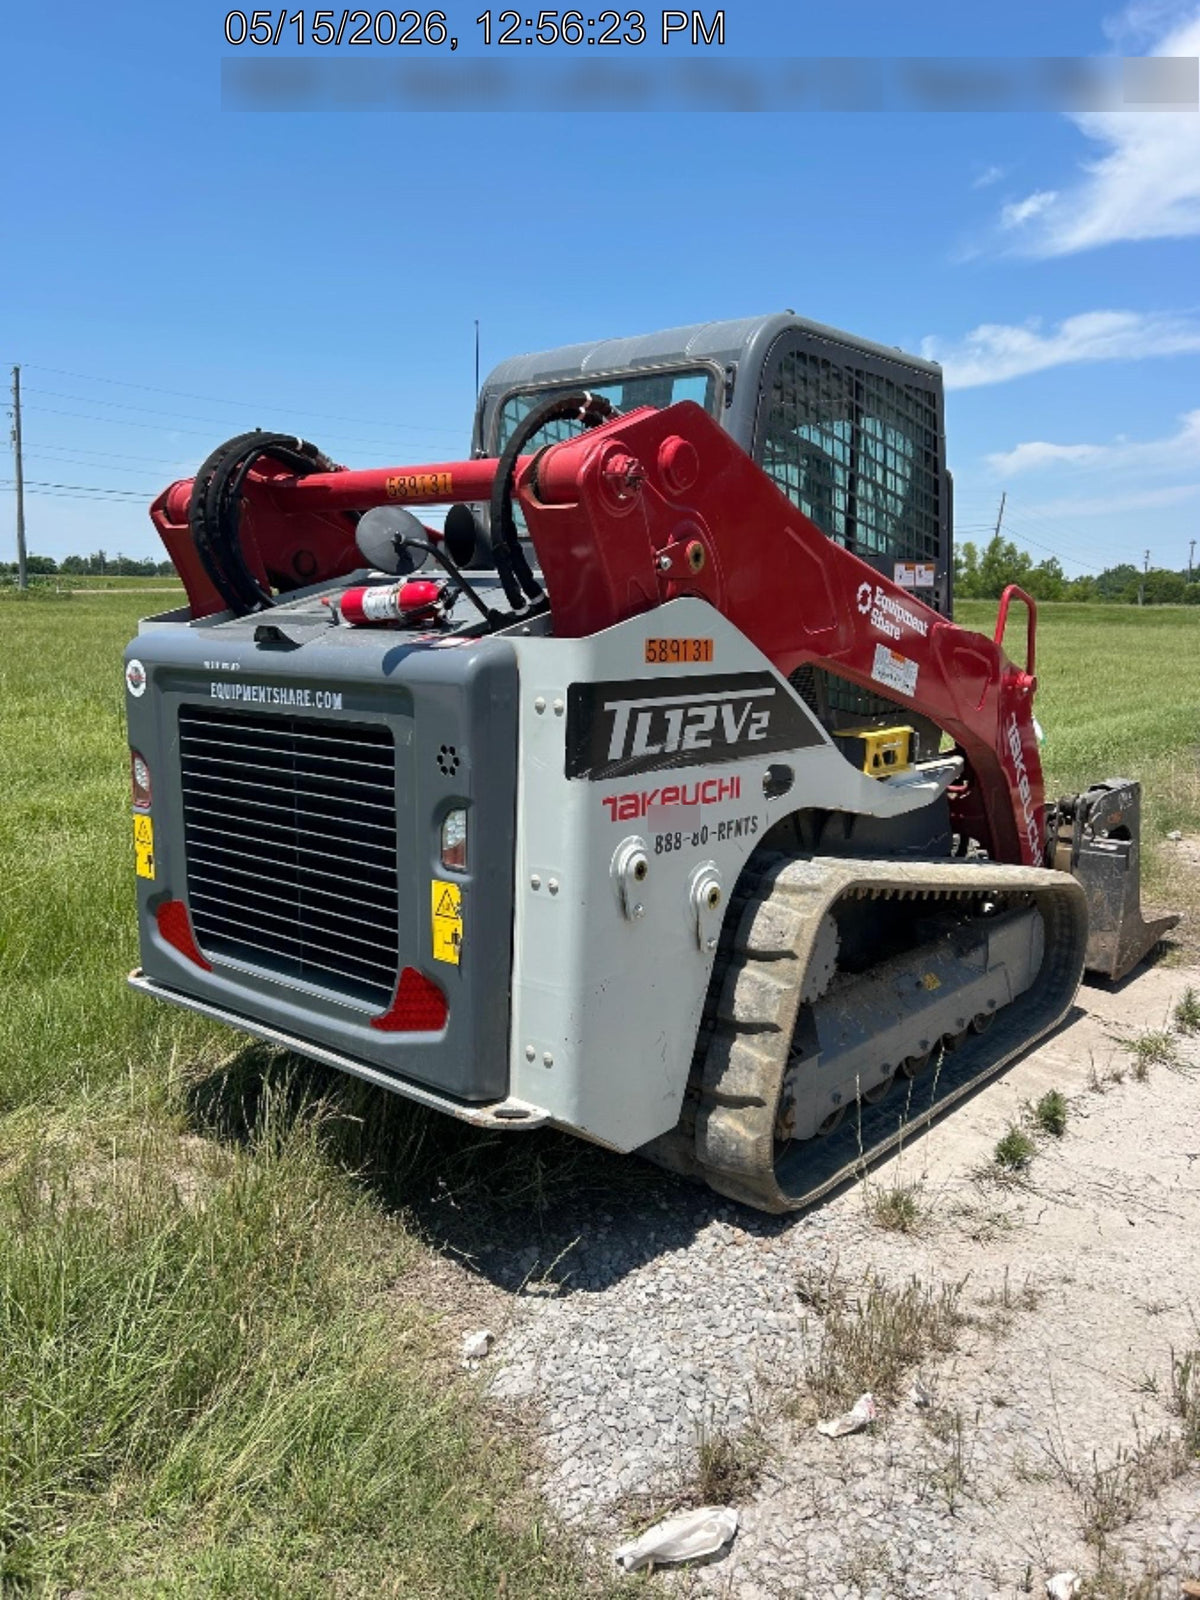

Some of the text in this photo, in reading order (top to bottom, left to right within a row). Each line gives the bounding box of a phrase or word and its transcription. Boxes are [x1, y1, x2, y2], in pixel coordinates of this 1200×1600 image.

[388, 474, 449, 497] 589131
[870, 608, 902, 641] Share
[874, 586, 929, 638] Equipment
[646, 639, 710, 662] 589131
[210, 682, 343, 711] EQUIPMENTSHARE.COM
